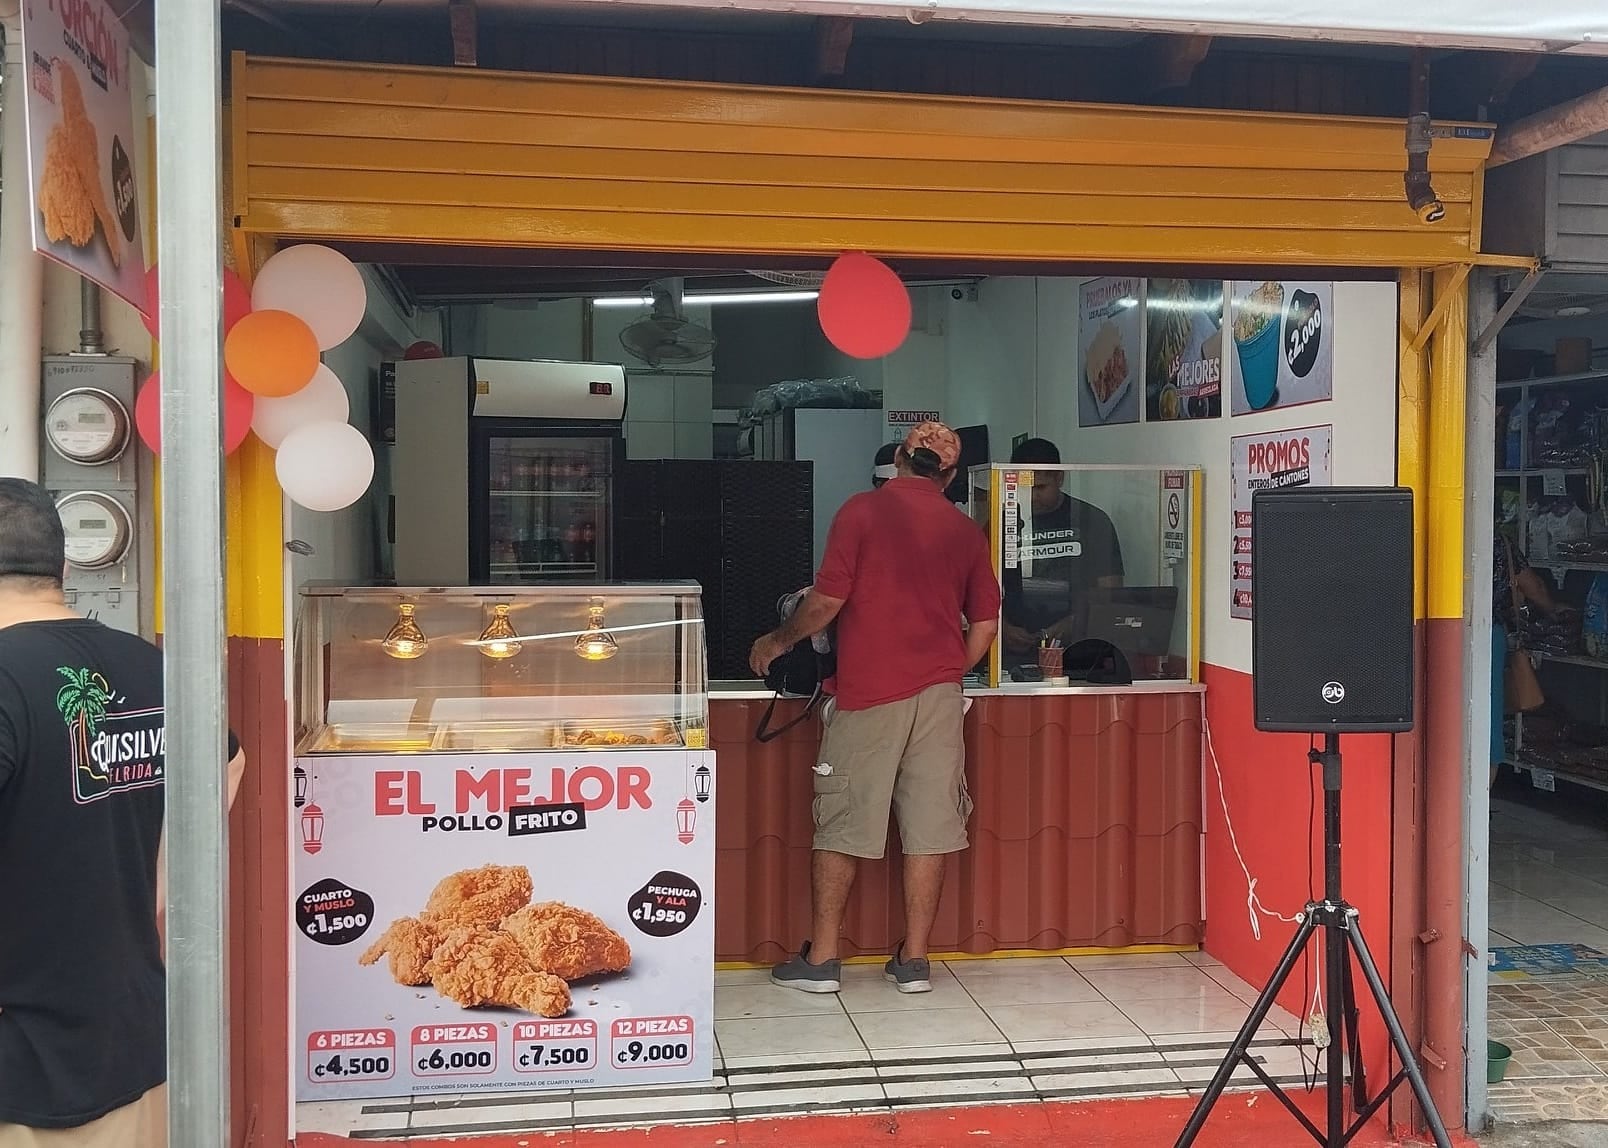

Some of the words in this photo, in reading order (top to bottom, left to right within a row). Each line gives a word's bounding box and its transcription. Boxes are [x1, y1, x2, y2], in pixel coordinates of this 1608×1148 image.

[1168, 355, 1179, 378] LAS
[1177, 357, 1220, 386] MEJORES
[889, 412, 938, 421] EXTINTOR
[1248, 437, 1310, 474] PROMOS
[1248, 478, 1270, 489] ENTEROS
[1271, 477, 1278, 488] DE
[1029, 529, 1074, 540] UNDER
[1018, 545, 1074, 557] ARMOUR
[375, 770, 436, 816] EL
[455, 766, 653, 814] MEJOR
[422, 815, 502, 832] POLLO
[515, 809, 578, 830] FRITO
[303, 889, 352, 904] CUARTO
[647, 885, 697, 898] PECHUGA
[303, 904, 311, 913] Y
[314, 898, 355, 912] MUSLO
[656, 895, 664, 904] Y
[665, 896, 687, 906] ALA
[420, 1030, 430, 1042] 8
[434, 1026, 489, 1041] PIEZAS
[519, 1025, 536, 1038] 10
[539, 1022, 593, 1037] PIEZAS
[616, 1021, 632, 1035] 12
[636, 1018, 688, 1034] PIEZAS
[316, 1034, 327, 1048] 6
[331, 1032, 386, 1047] PIEZAS
